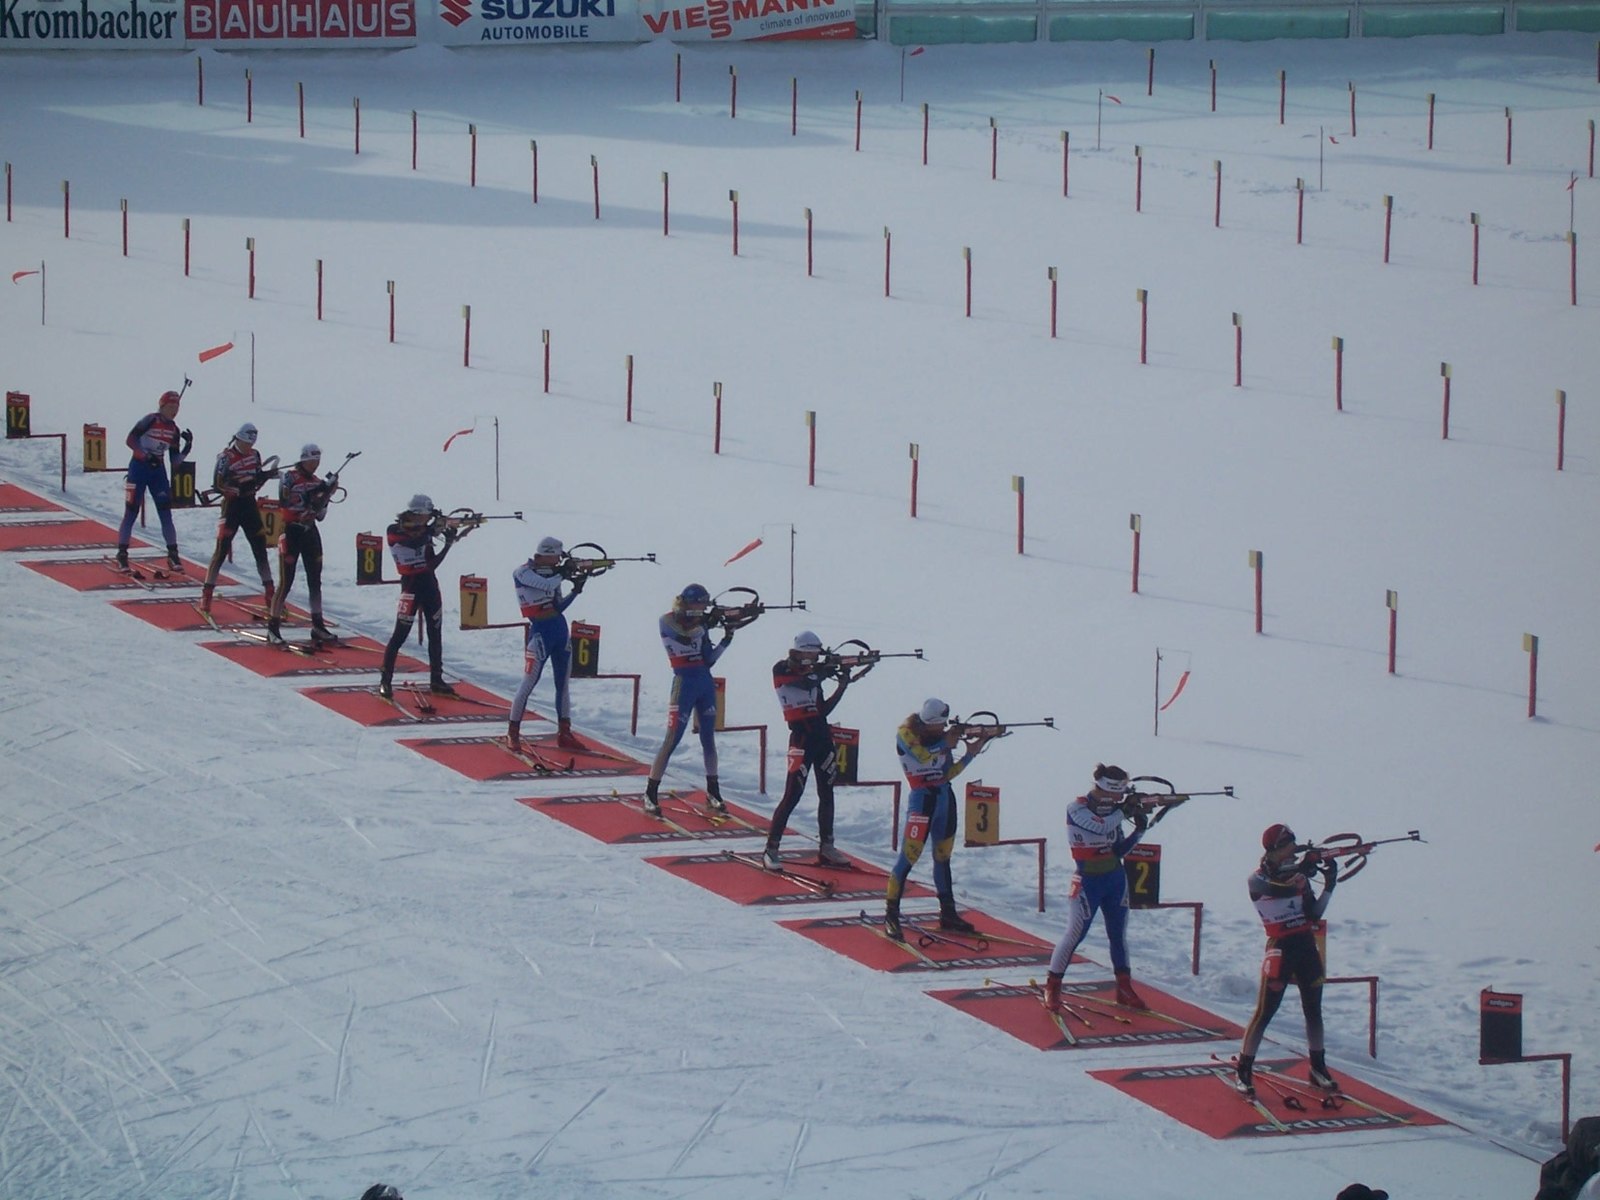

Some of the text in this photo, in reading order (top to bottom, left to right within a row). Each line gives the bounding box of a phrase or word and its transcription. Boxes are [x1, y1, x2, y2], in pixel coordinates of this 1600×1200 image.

[0, 0, 177, 39] Krombacher
[191, 3, 411, 33] BAUHAUS
[481, 0, 615, 20] SUZUKI
[760, 9, 851, 30] climate of innovation
[481, 25, 589, 41] AUTOMOBILE
[9, 406, 27, 429] 12
[87, 439, 102, 462] 11
[174, 474, 193, 498] 10
[266, 512, 275, 537] 9
[364, 548, 376, 573] 8
[468, 592, 478, 617] 7
[578, 638, 590, 666] 6
[836, 744, 848, 774] 4
[976, 802, 989, 833] 3
[910, 825, 919, 839] 8
[1135, 861, 1149, 894] 2
[1254, 1116, 1390, 1133] erdgas
